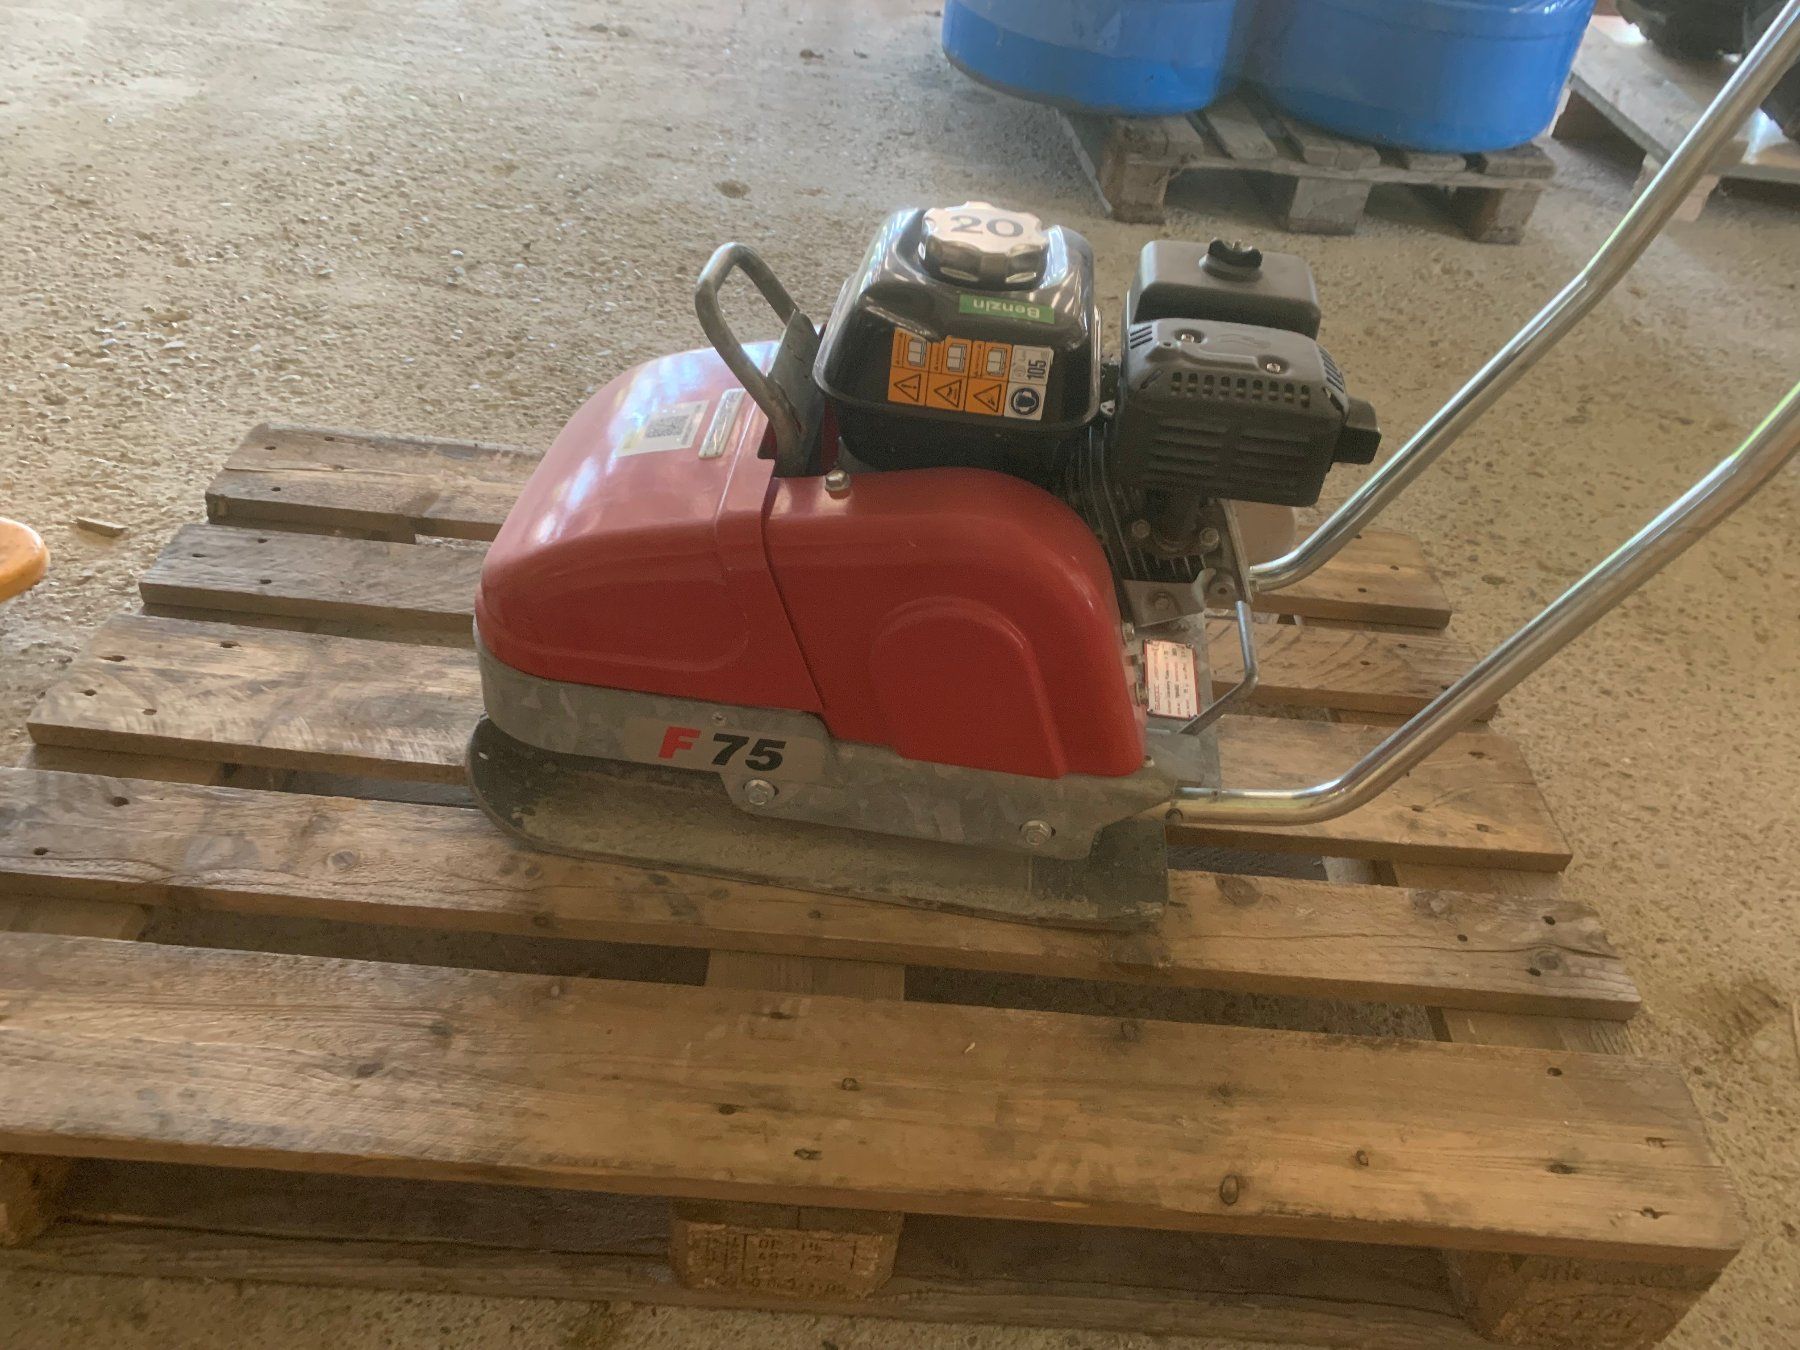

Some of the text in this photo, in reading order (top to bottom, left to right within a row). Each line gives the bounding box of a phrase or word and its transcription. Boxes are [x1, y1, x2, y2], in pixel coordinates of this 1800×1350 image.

[950, 215, 1024, 238] 20
[973, 299, 1041, 319] Benzin
[1027, 359, 1047, 380] 105
[658, 725, 787, 772] F 75
